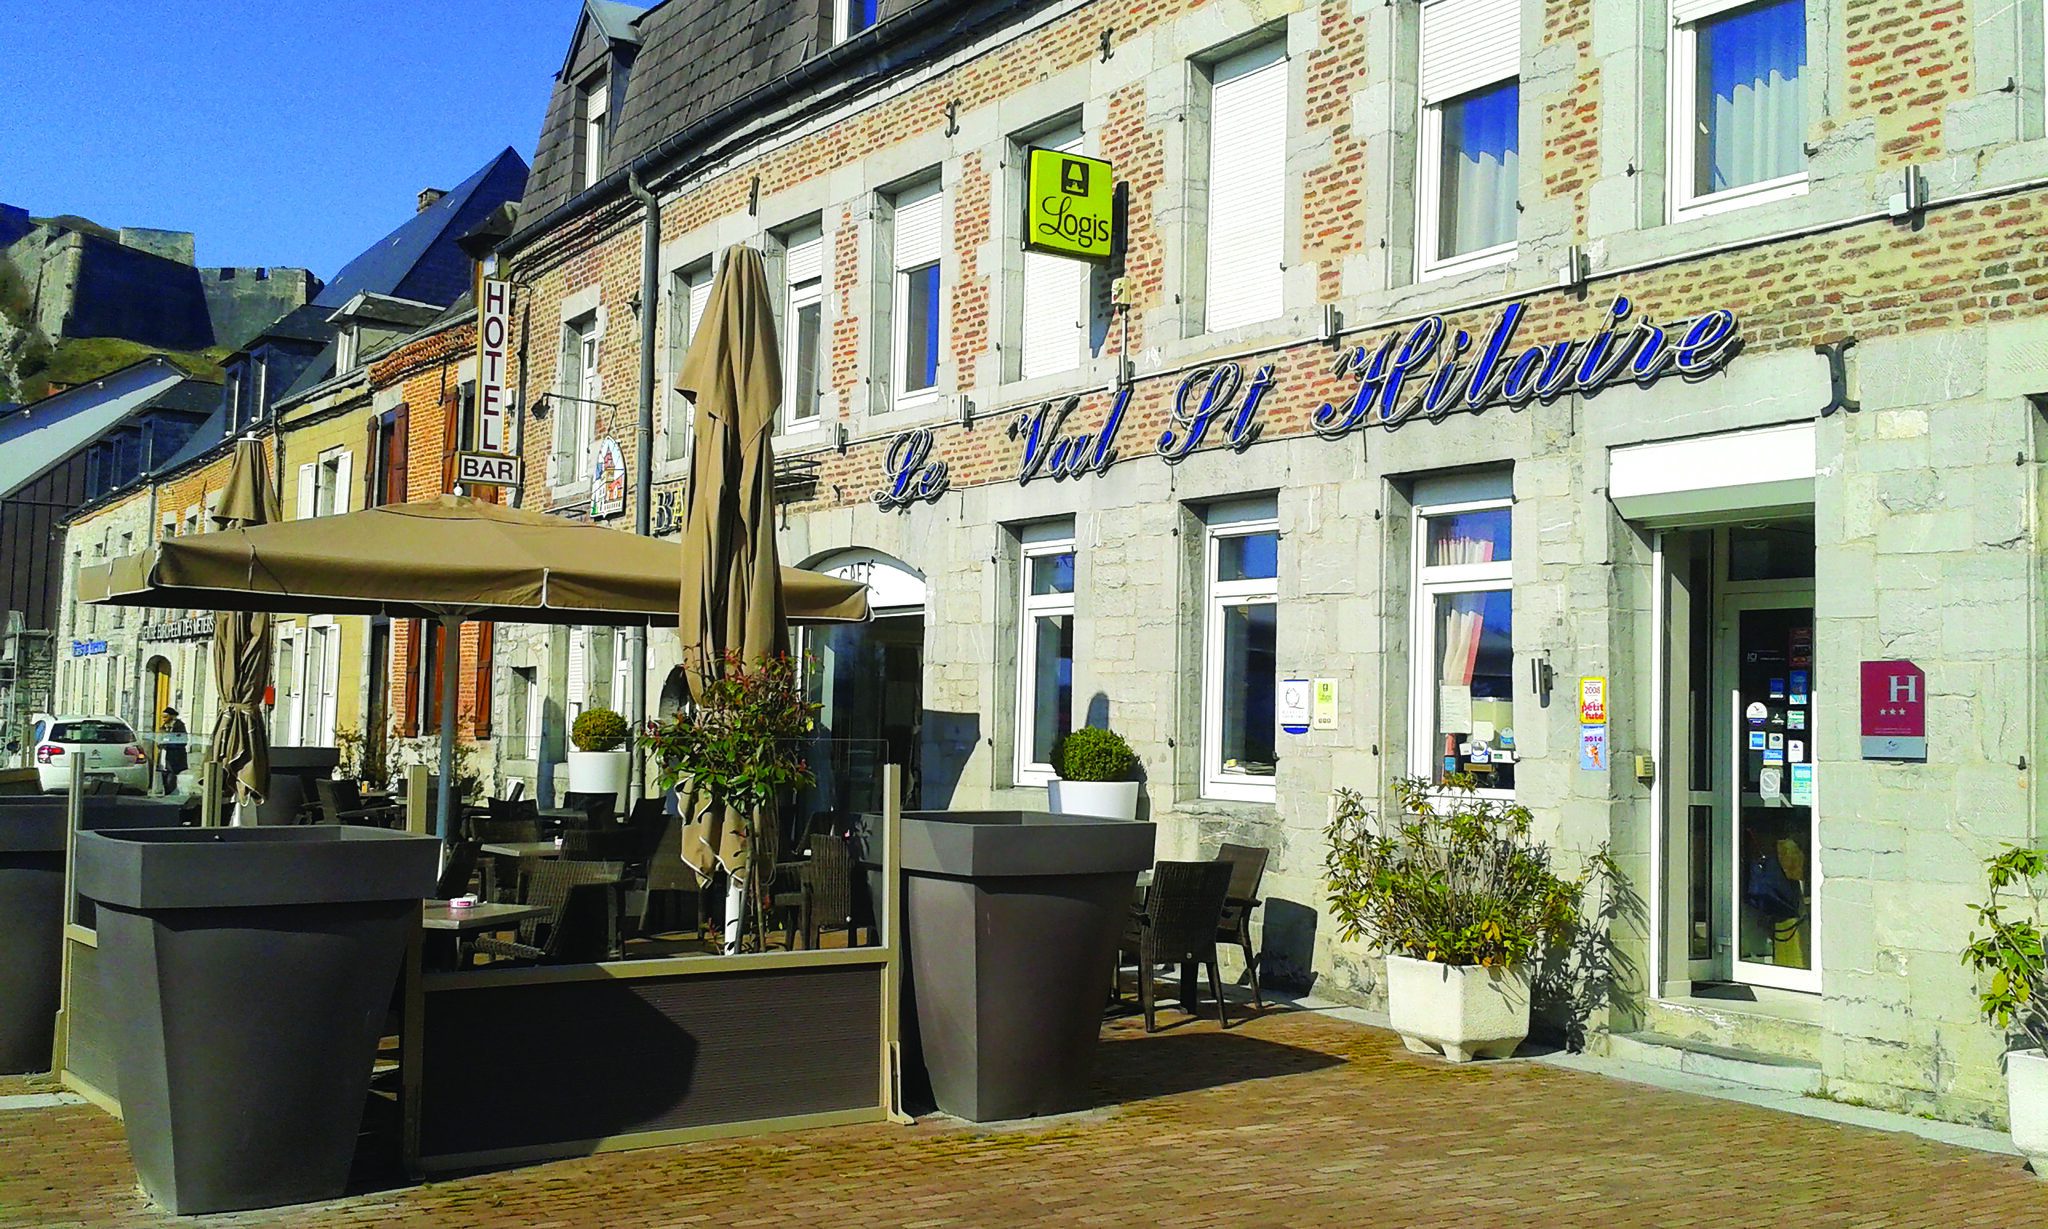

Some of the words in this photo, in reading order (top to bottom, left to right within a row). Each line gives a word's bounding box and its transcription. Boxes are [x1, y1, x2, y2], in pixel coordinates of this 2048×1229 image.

[1039, 196, 1109, 248] Logis
[482, 282, 505, 451] HOTEL
[870, 429, 949, 507] Le
[1006, 384, 1133, 484] Val
[1156, 362, 1276, 460] St
[1311, 293, 1742, 434] Hilaire
[463, 458, 514, 480] BAR
[1584, 686, 1601, 695] 2008
[1887, 674, 1919, 703] H
